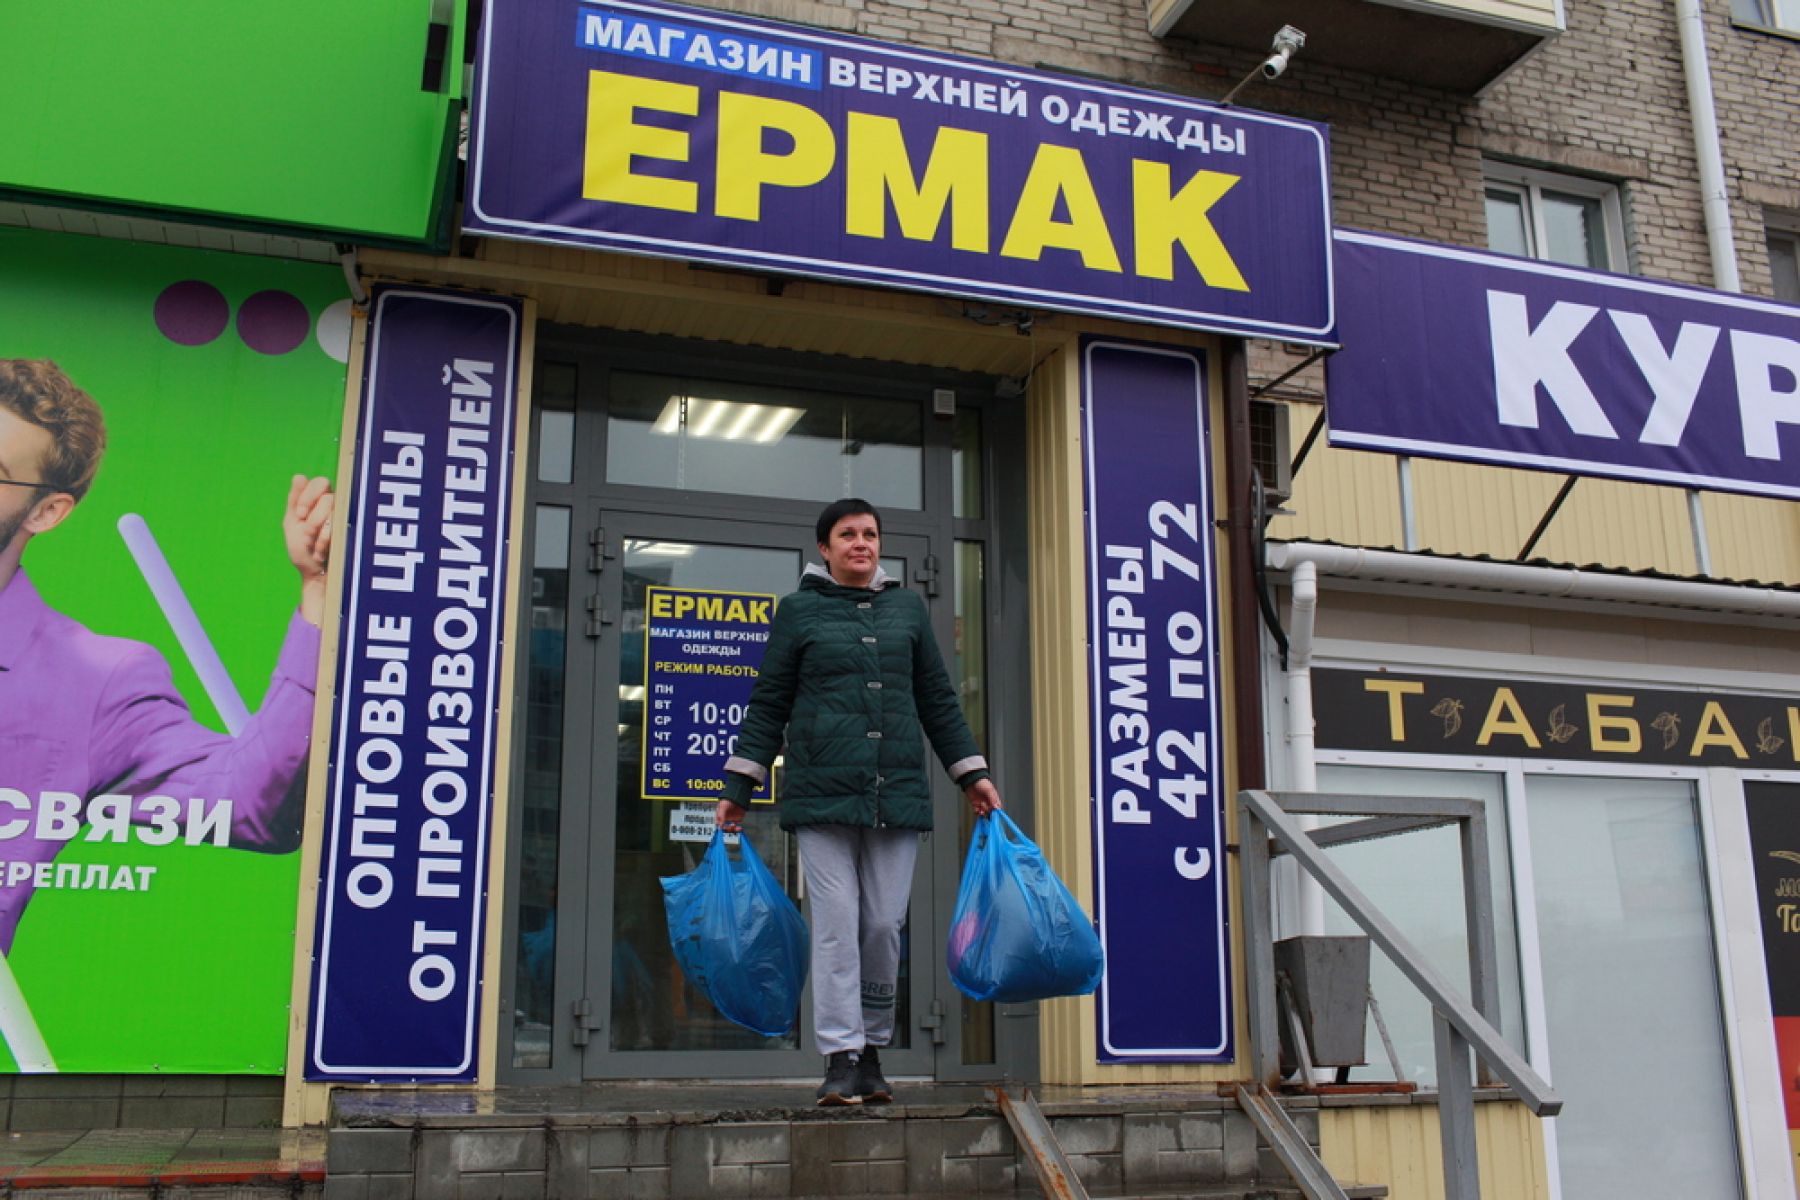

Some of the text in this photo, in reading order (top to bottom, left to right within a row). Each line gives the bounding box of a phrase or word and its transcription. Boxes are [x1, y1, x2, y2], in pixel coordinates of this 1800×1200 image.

[584, 15, 1246, 155] МАГАЗИН ВЕРХНЕЙ ОДЕЖДЫ
[582, 69, 1250, 292] ЕРМАК
[1487, 289, 1800, 461] КУР
[1148, 500, 1200, 581] 72
[652, 593, 771, 624] ЕРМАК
[650, 627, 710, 640] МАГАЗИН
[682, 643, 741, 657] ОДЕЖДЫ
[346, 429, 425, 909] ОПТОВЫЕ ЦЕНЫ
[409, 358, 494, 1002] ОТ ПРОИЗВОДИТЕЛЕЙ
[655, 661, 703, 674] РЕЖИМ
[654, 683, 674, 694] ПН
[1105, 544, 1151, 825] РАЗМЕРЫ
[654, 699, 672, 710] ВТ
[654, 715, 672, 725] СР
[654, 731, 671, 741] ЧТ
[653, 747, 671, 757] ПТ
[653, 762, 671, 773] СБ
[1156, 729, 1207, 818] 42
[652, 778, 671, 789] ВС
[0, 787, 233, 847] СВЯЗИ
[0, 861, 157, 891] РЕПЛАТ
